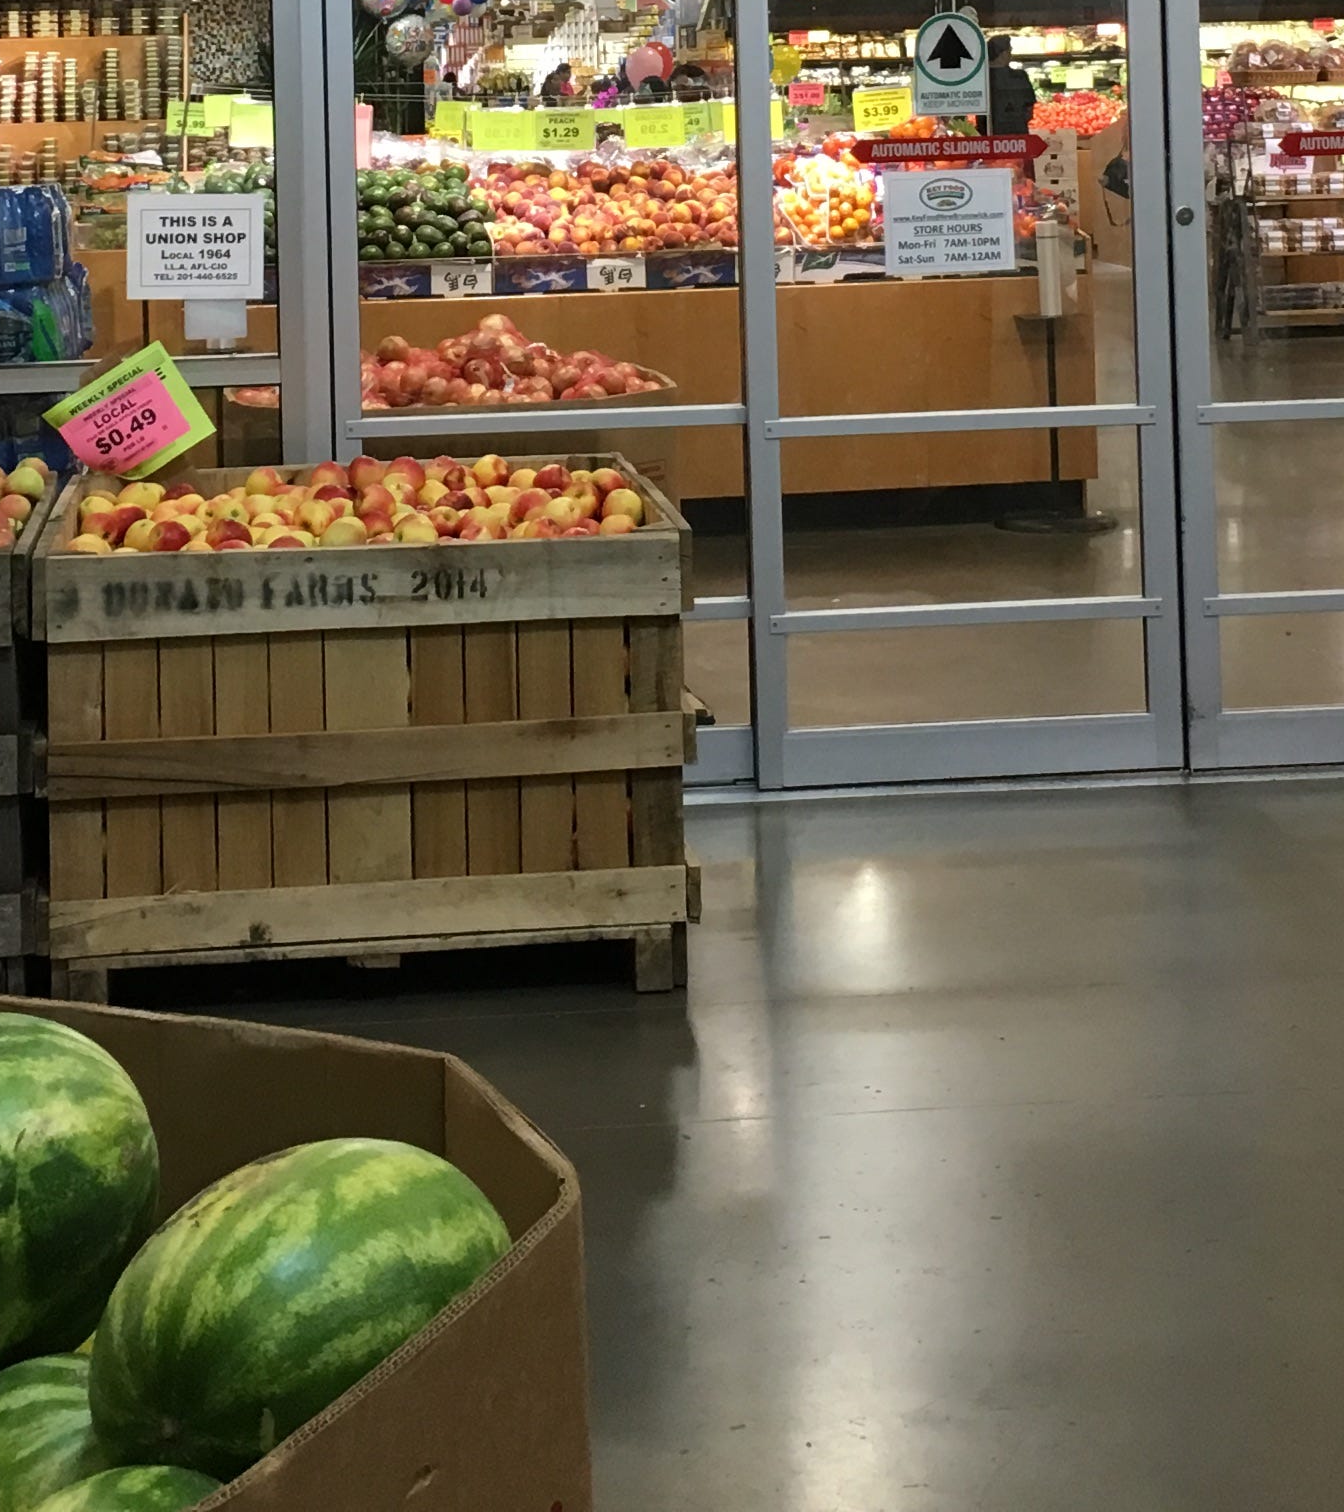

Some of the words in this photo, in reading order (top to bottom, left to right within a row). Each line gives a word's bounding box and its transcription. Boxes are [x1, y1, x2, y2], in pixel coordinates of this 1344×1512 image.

[920, 91, 959, 100] AUTOMATIC
[959, 90, 983, 99] DOOR
[863, 105, 899, 118] $3.99
[176, 120, 205, 129] $.99
[549, 117, 575, 125] PEACH
[542, 127, 580, 139] $1.29
[871, 142, 941, 157] AUTOMATIC
[942, 140, 990, 155] SLIDING
[993, 139, 1026, 153] DOOR
[159, 216, 197, 227] THIS
[202, 216, 217, 227] IS
[222, 216, 233, 227] A
[913, 225, 944, 235] STORE
[947, 223, 983, 233] HOURS
[145, 233, 198, 245] UNION
[203, 232, 247, 244] SHOP
[898, 239, 936, 250] Mon-Fri
[944, 237, 1000, 248] 7AM-10PM
[198, 249, 231, 260] 1964
[898, 254, 934, 265] Sat-Sun
[944, 252, 1001, 262] 7AM-12AM
[69, 390, 105, 416] WEEKLY
[106, 366, 144, 393] SPECIAL
[93, 399, 137, 429] LOCAL
[95, 408, 157, 455] $0.49
[410, 567, 489, 601] 2014
